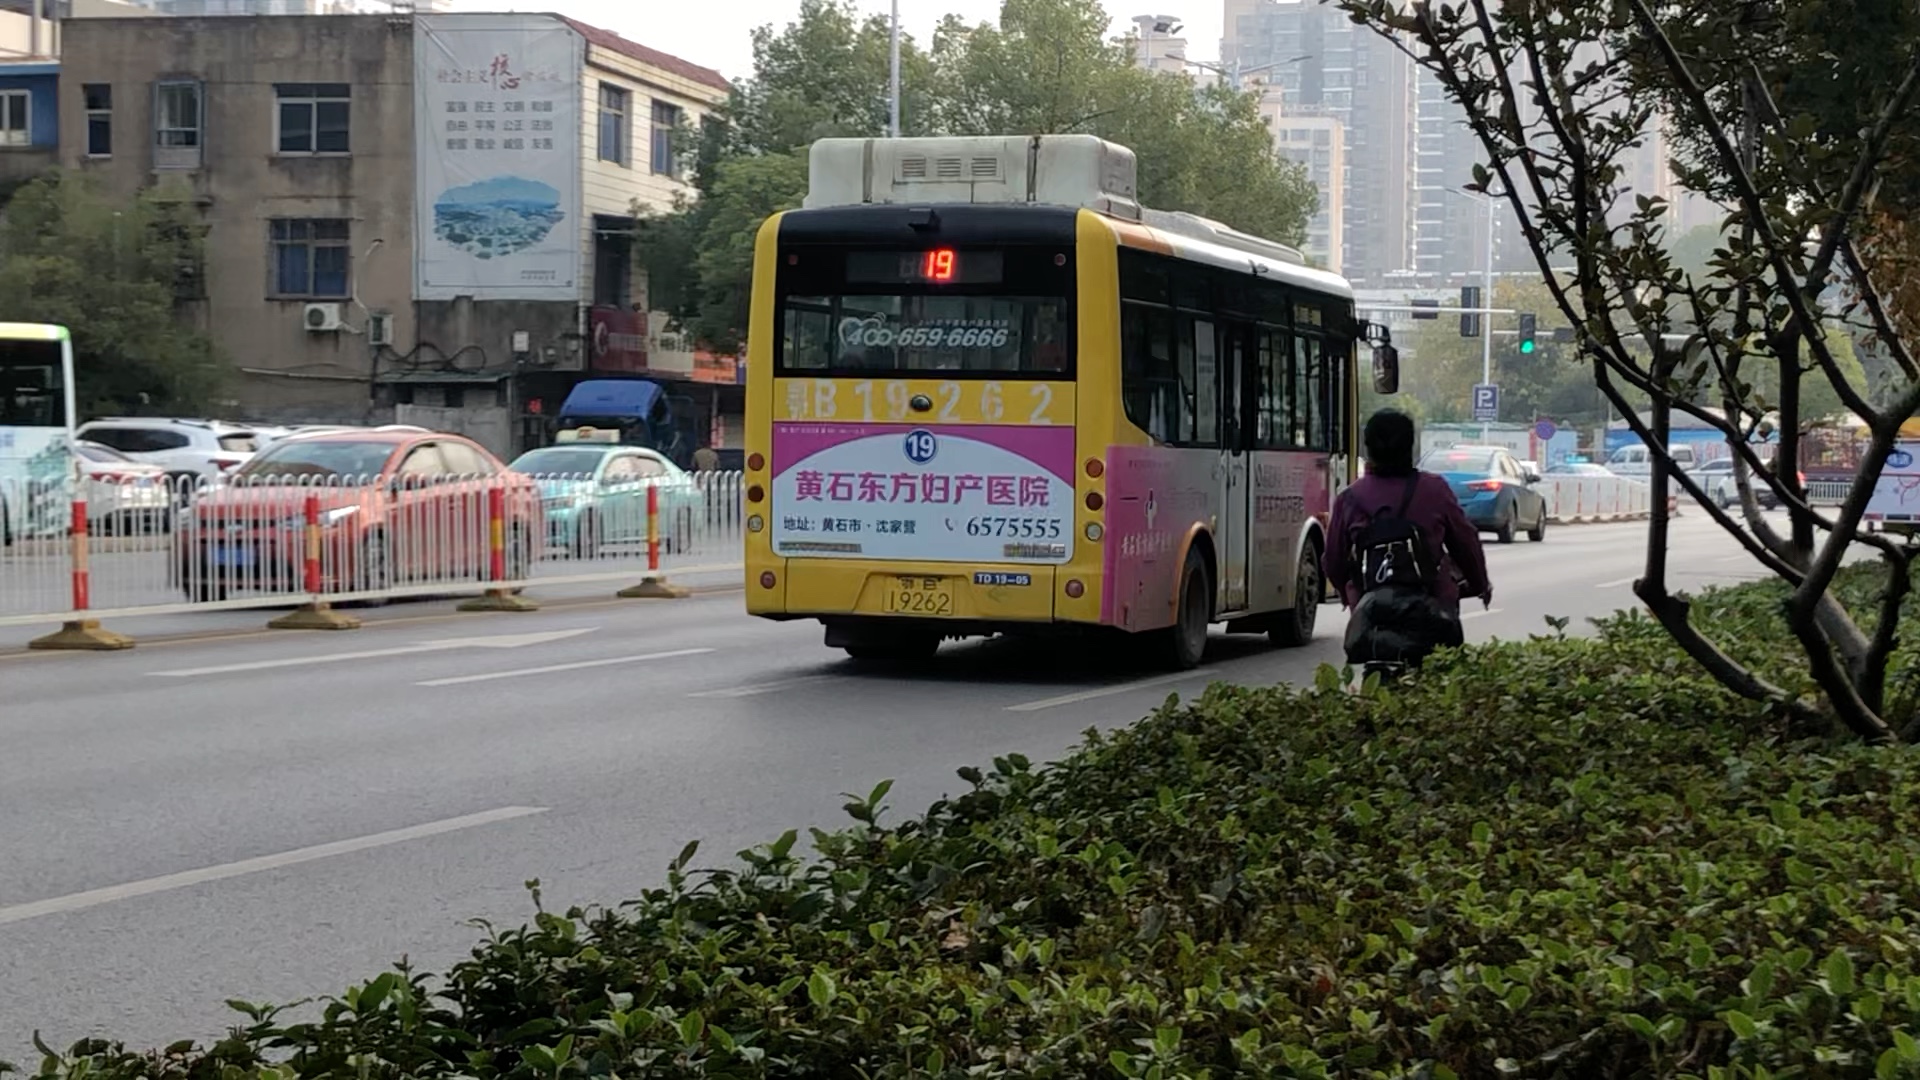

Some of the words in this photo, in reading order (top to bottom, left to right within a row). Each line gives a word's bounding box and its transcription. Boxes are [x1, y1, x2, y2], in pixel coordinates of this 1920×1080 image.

[927, 250, 953, 279] 19
[1478, 390, 1492, 407] P
[908, 434, 934, 459] 19
[795, 470, 1050, 507] 黄石东方妇产医院
[966, 517, 1061, 538] 6575555
[890, 591, 950, 613] 19262
